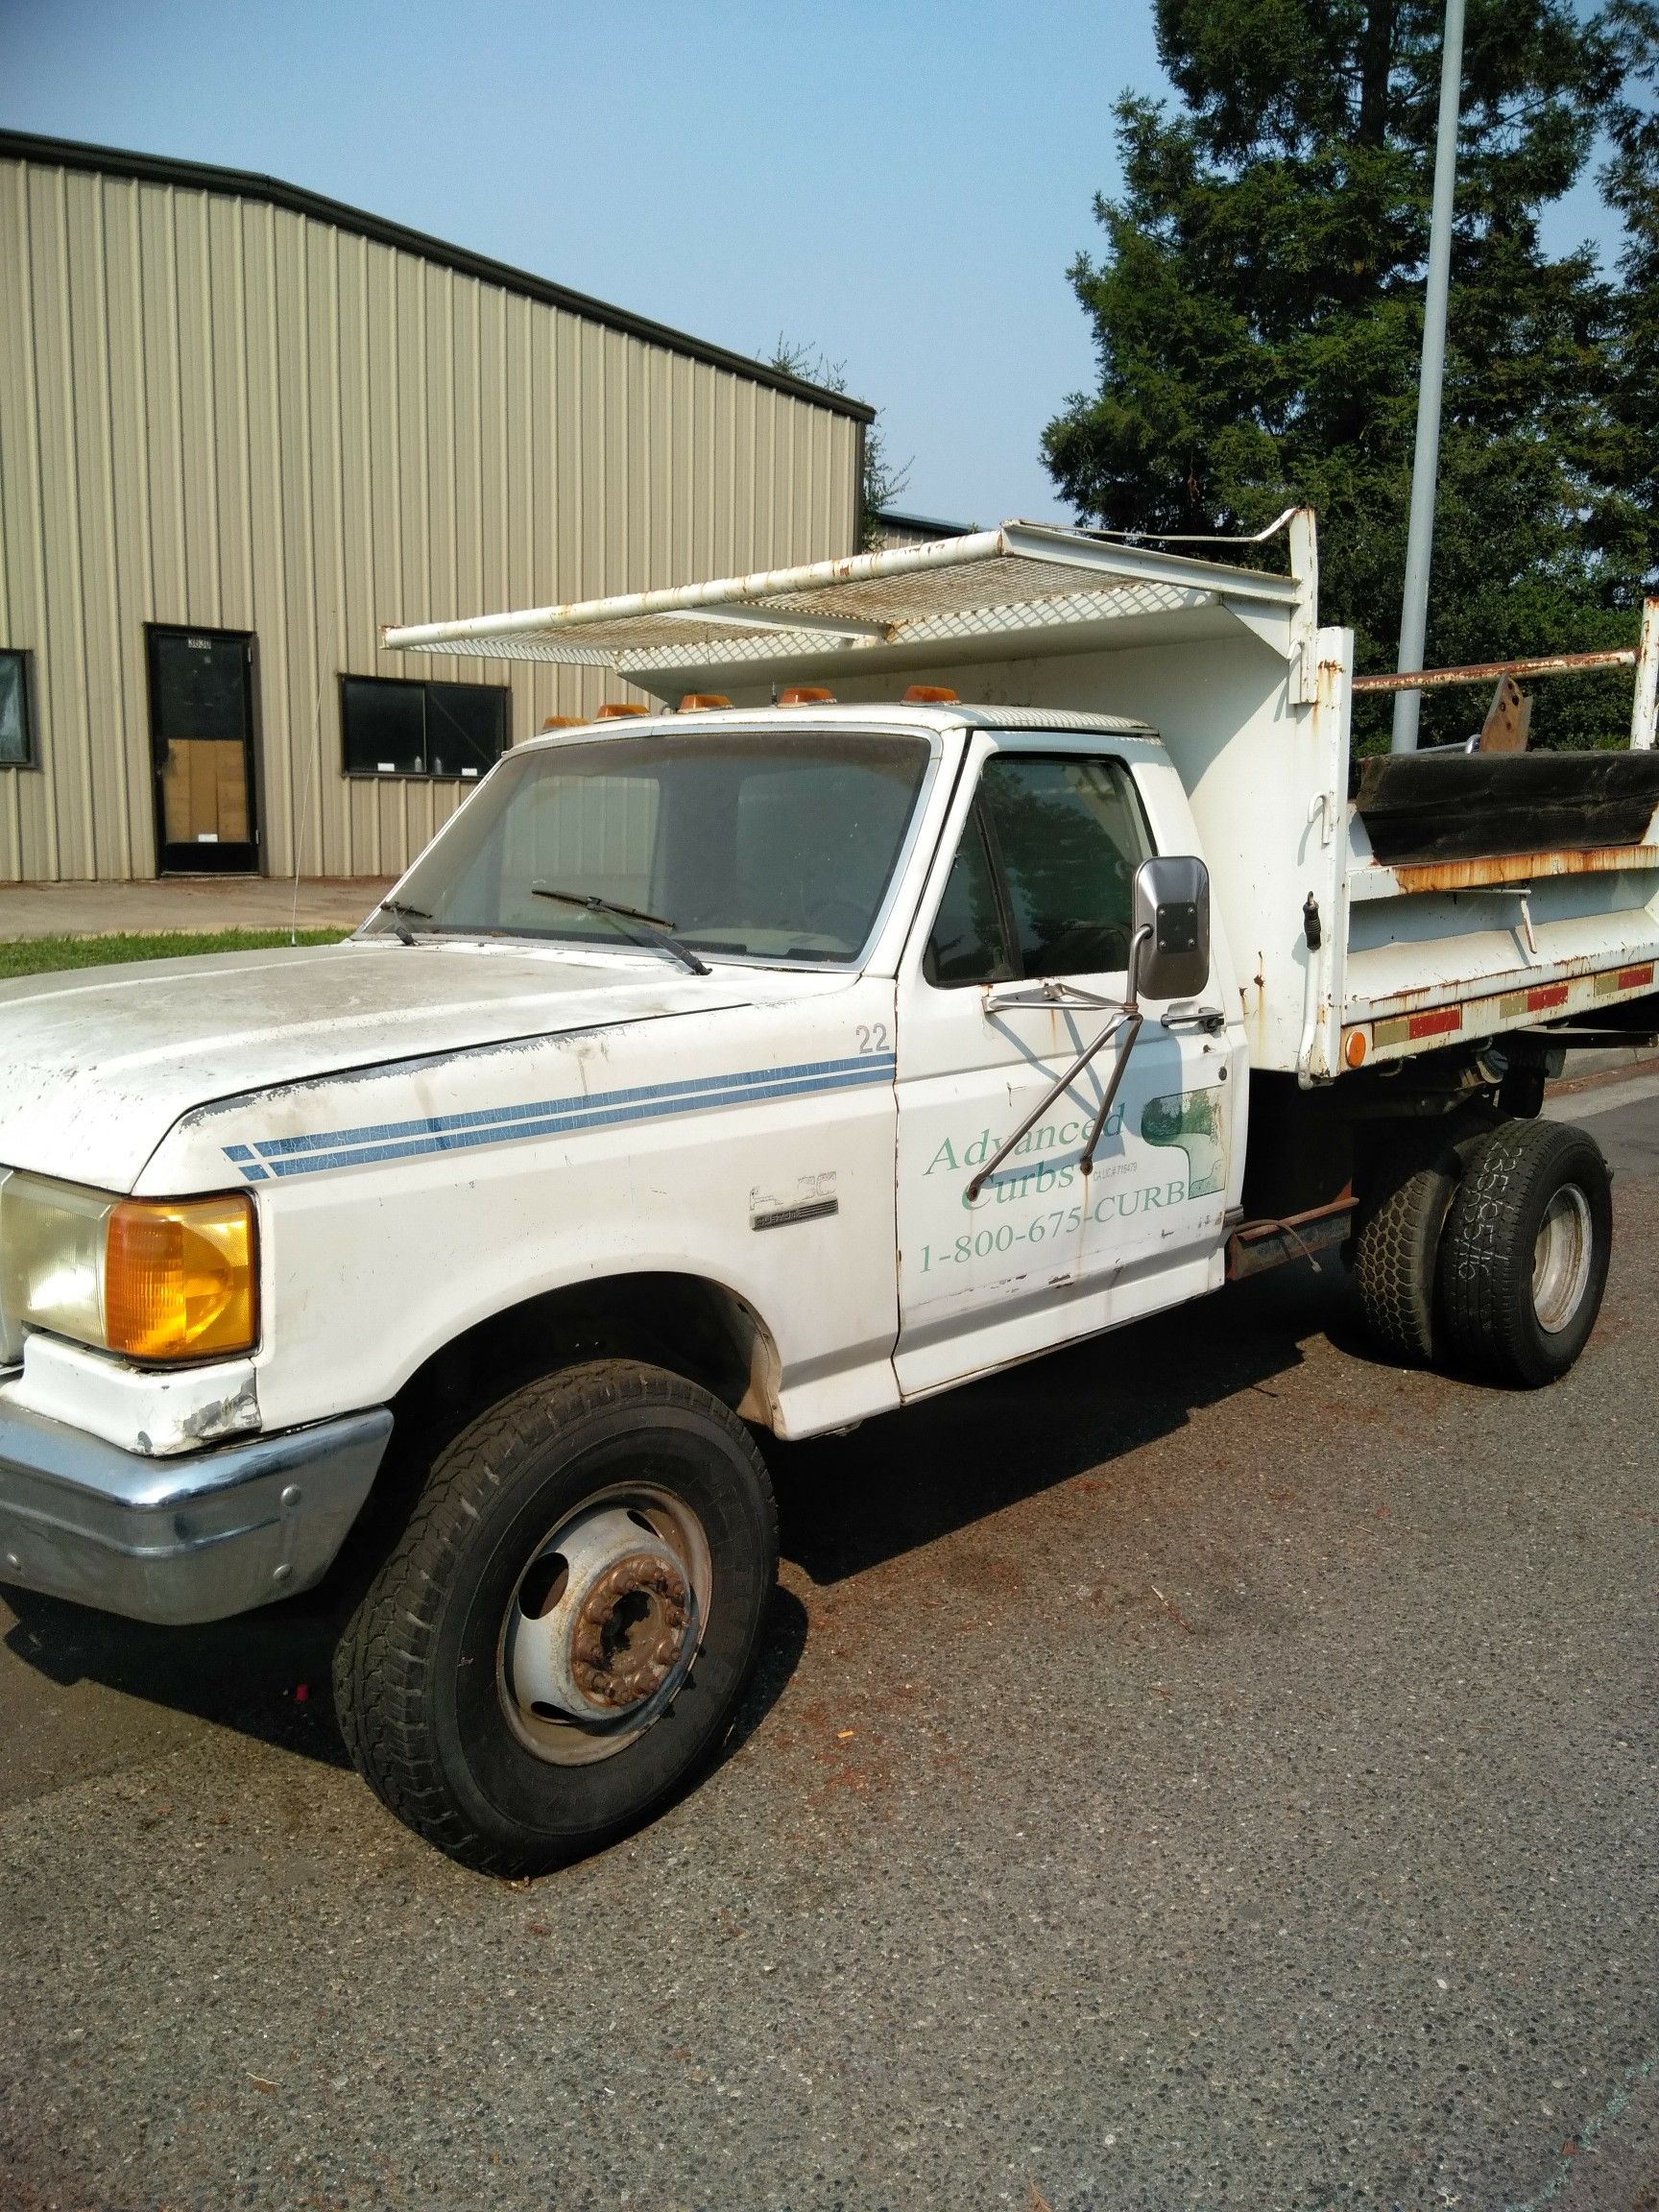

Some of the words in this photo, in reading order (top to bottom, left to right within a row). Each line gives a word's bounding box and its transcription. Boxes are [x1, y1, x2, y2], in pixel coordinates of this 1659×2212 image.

[855, 1022, 890, 1054] 22
[923, 1103, 1125, 1175] Advanced
[962, 1161, 1074, 1211] Curbs
[919, 1181, 1185, 1273] 1-800-675-CURB
